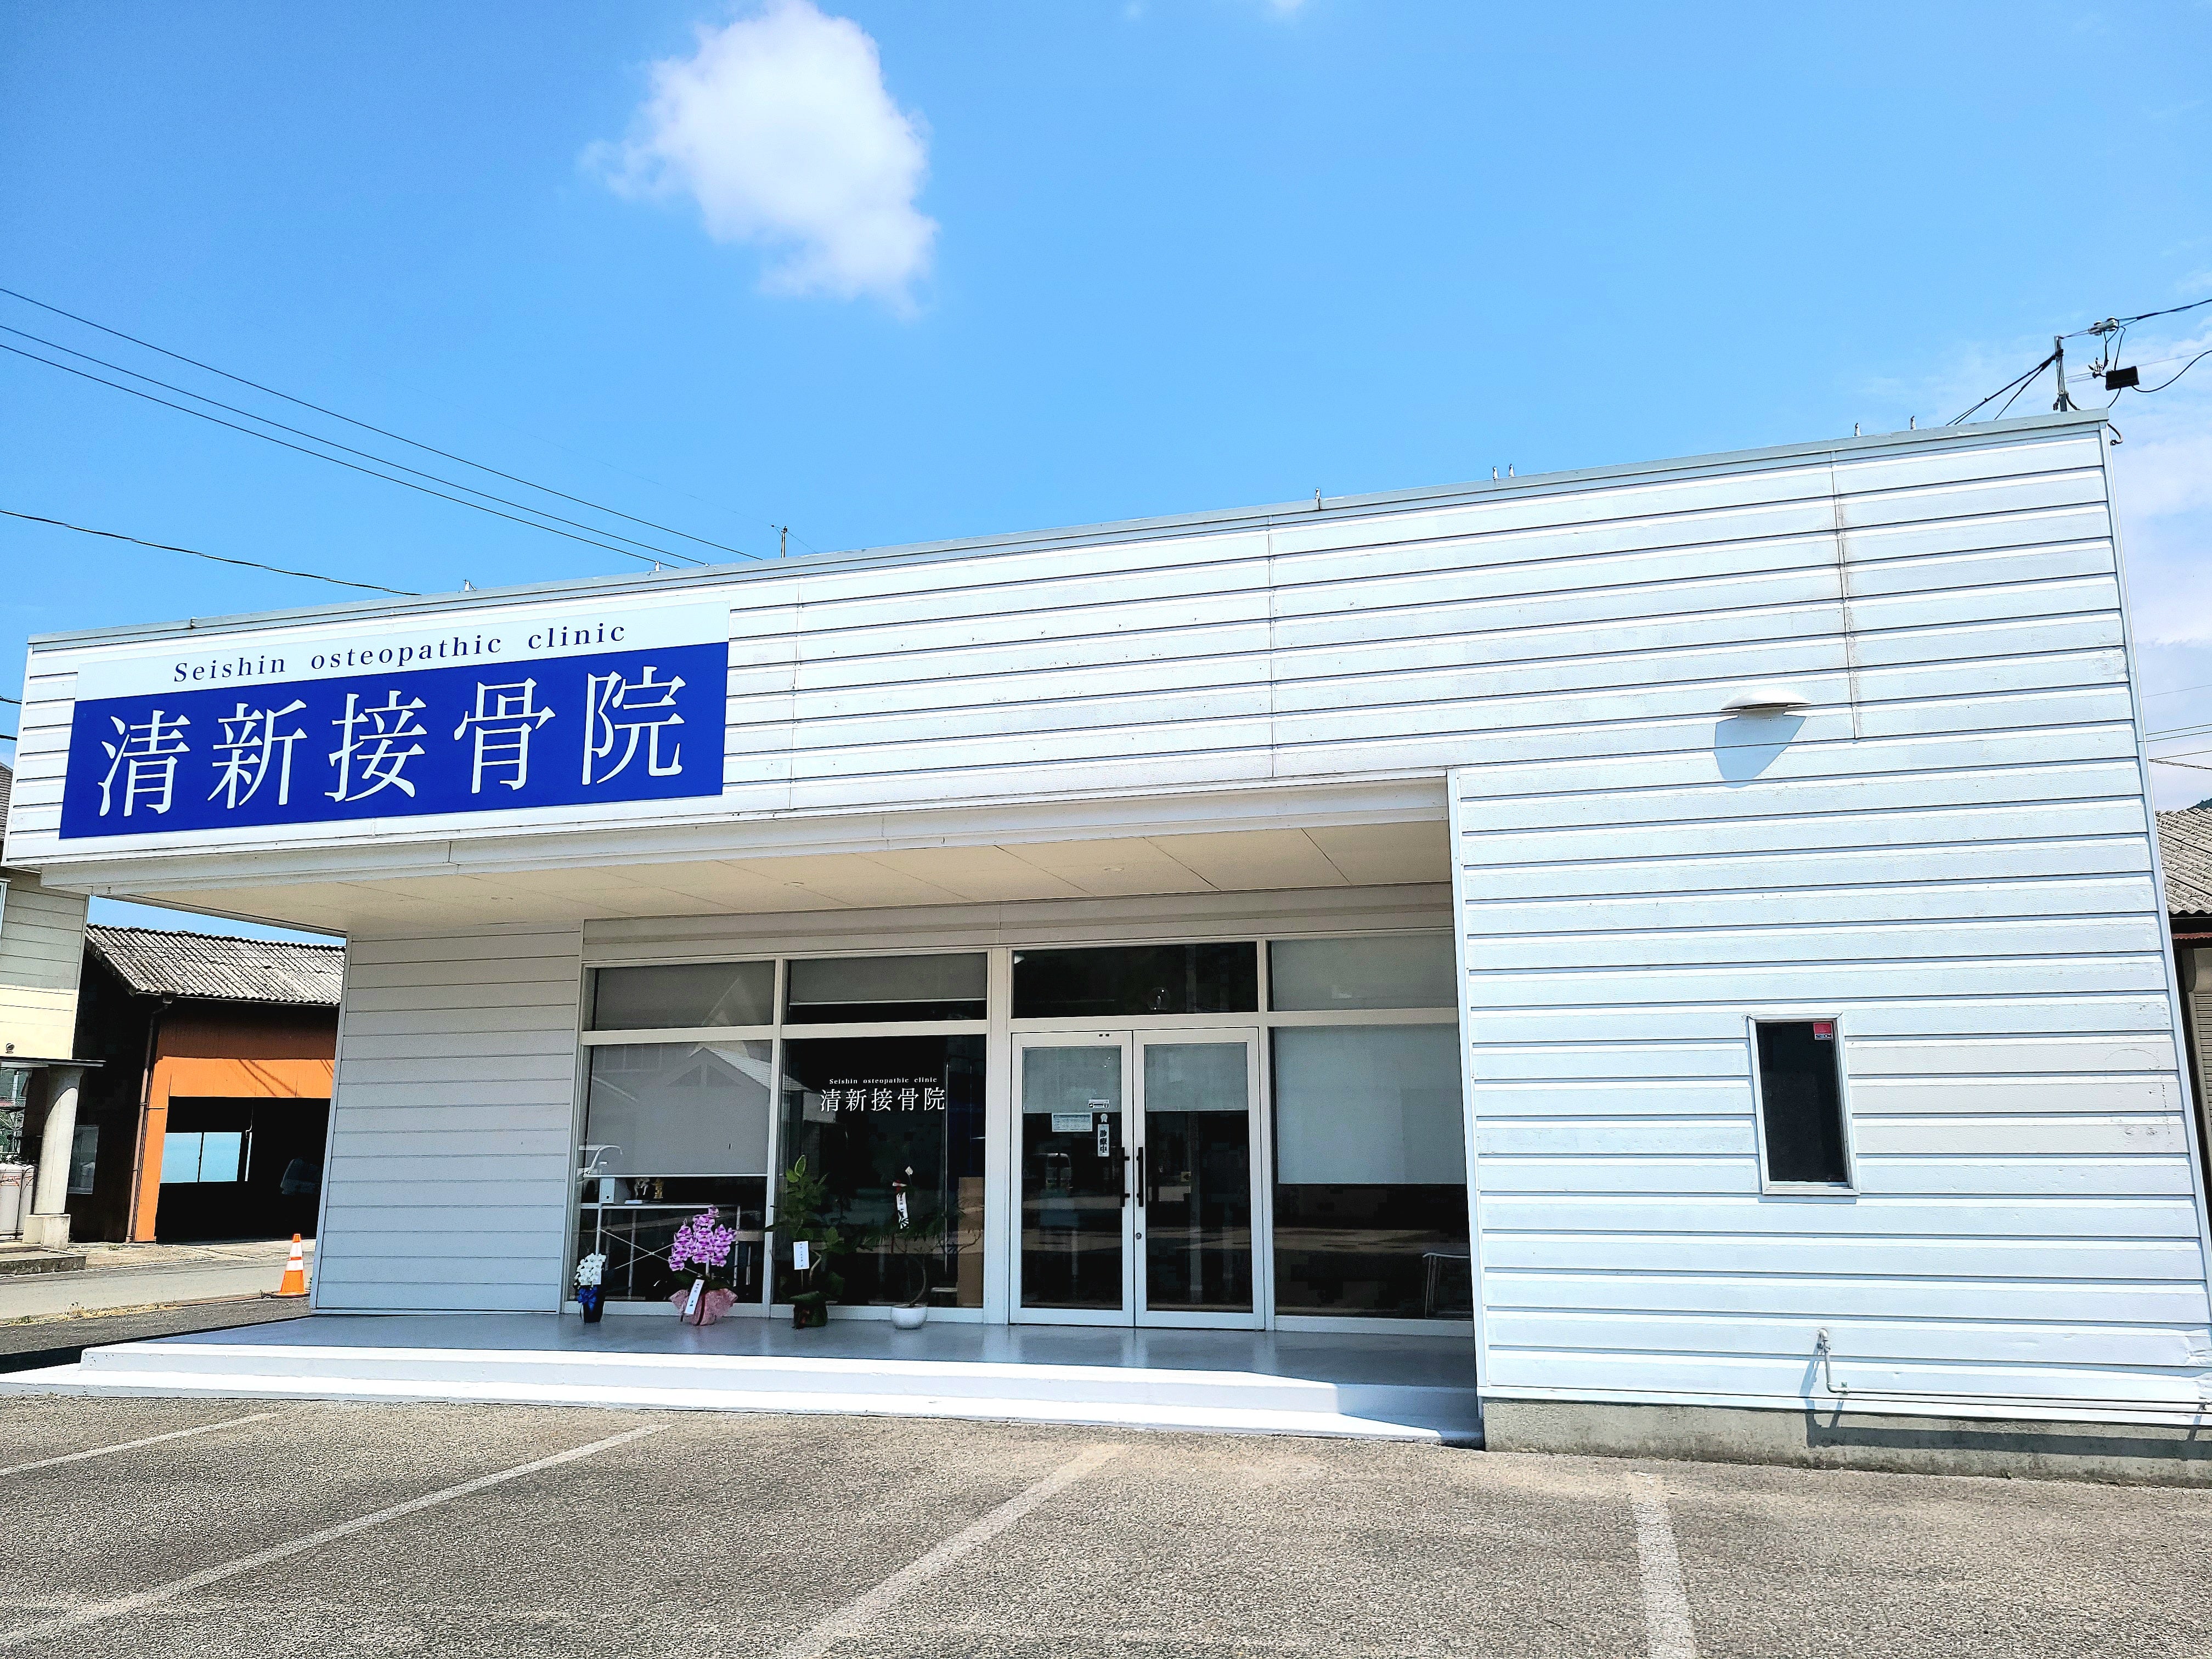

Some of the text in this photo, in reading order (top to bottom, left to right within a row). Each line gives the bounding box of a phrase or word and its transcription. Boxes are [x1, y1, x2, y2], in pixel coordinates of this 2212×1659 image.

[174, 623, 625, 682] Seishin osteopathic clinic
[97, 666, 687, 817] 清新接骨院
[820, 1087, 945, 1112] 清新接骨院
